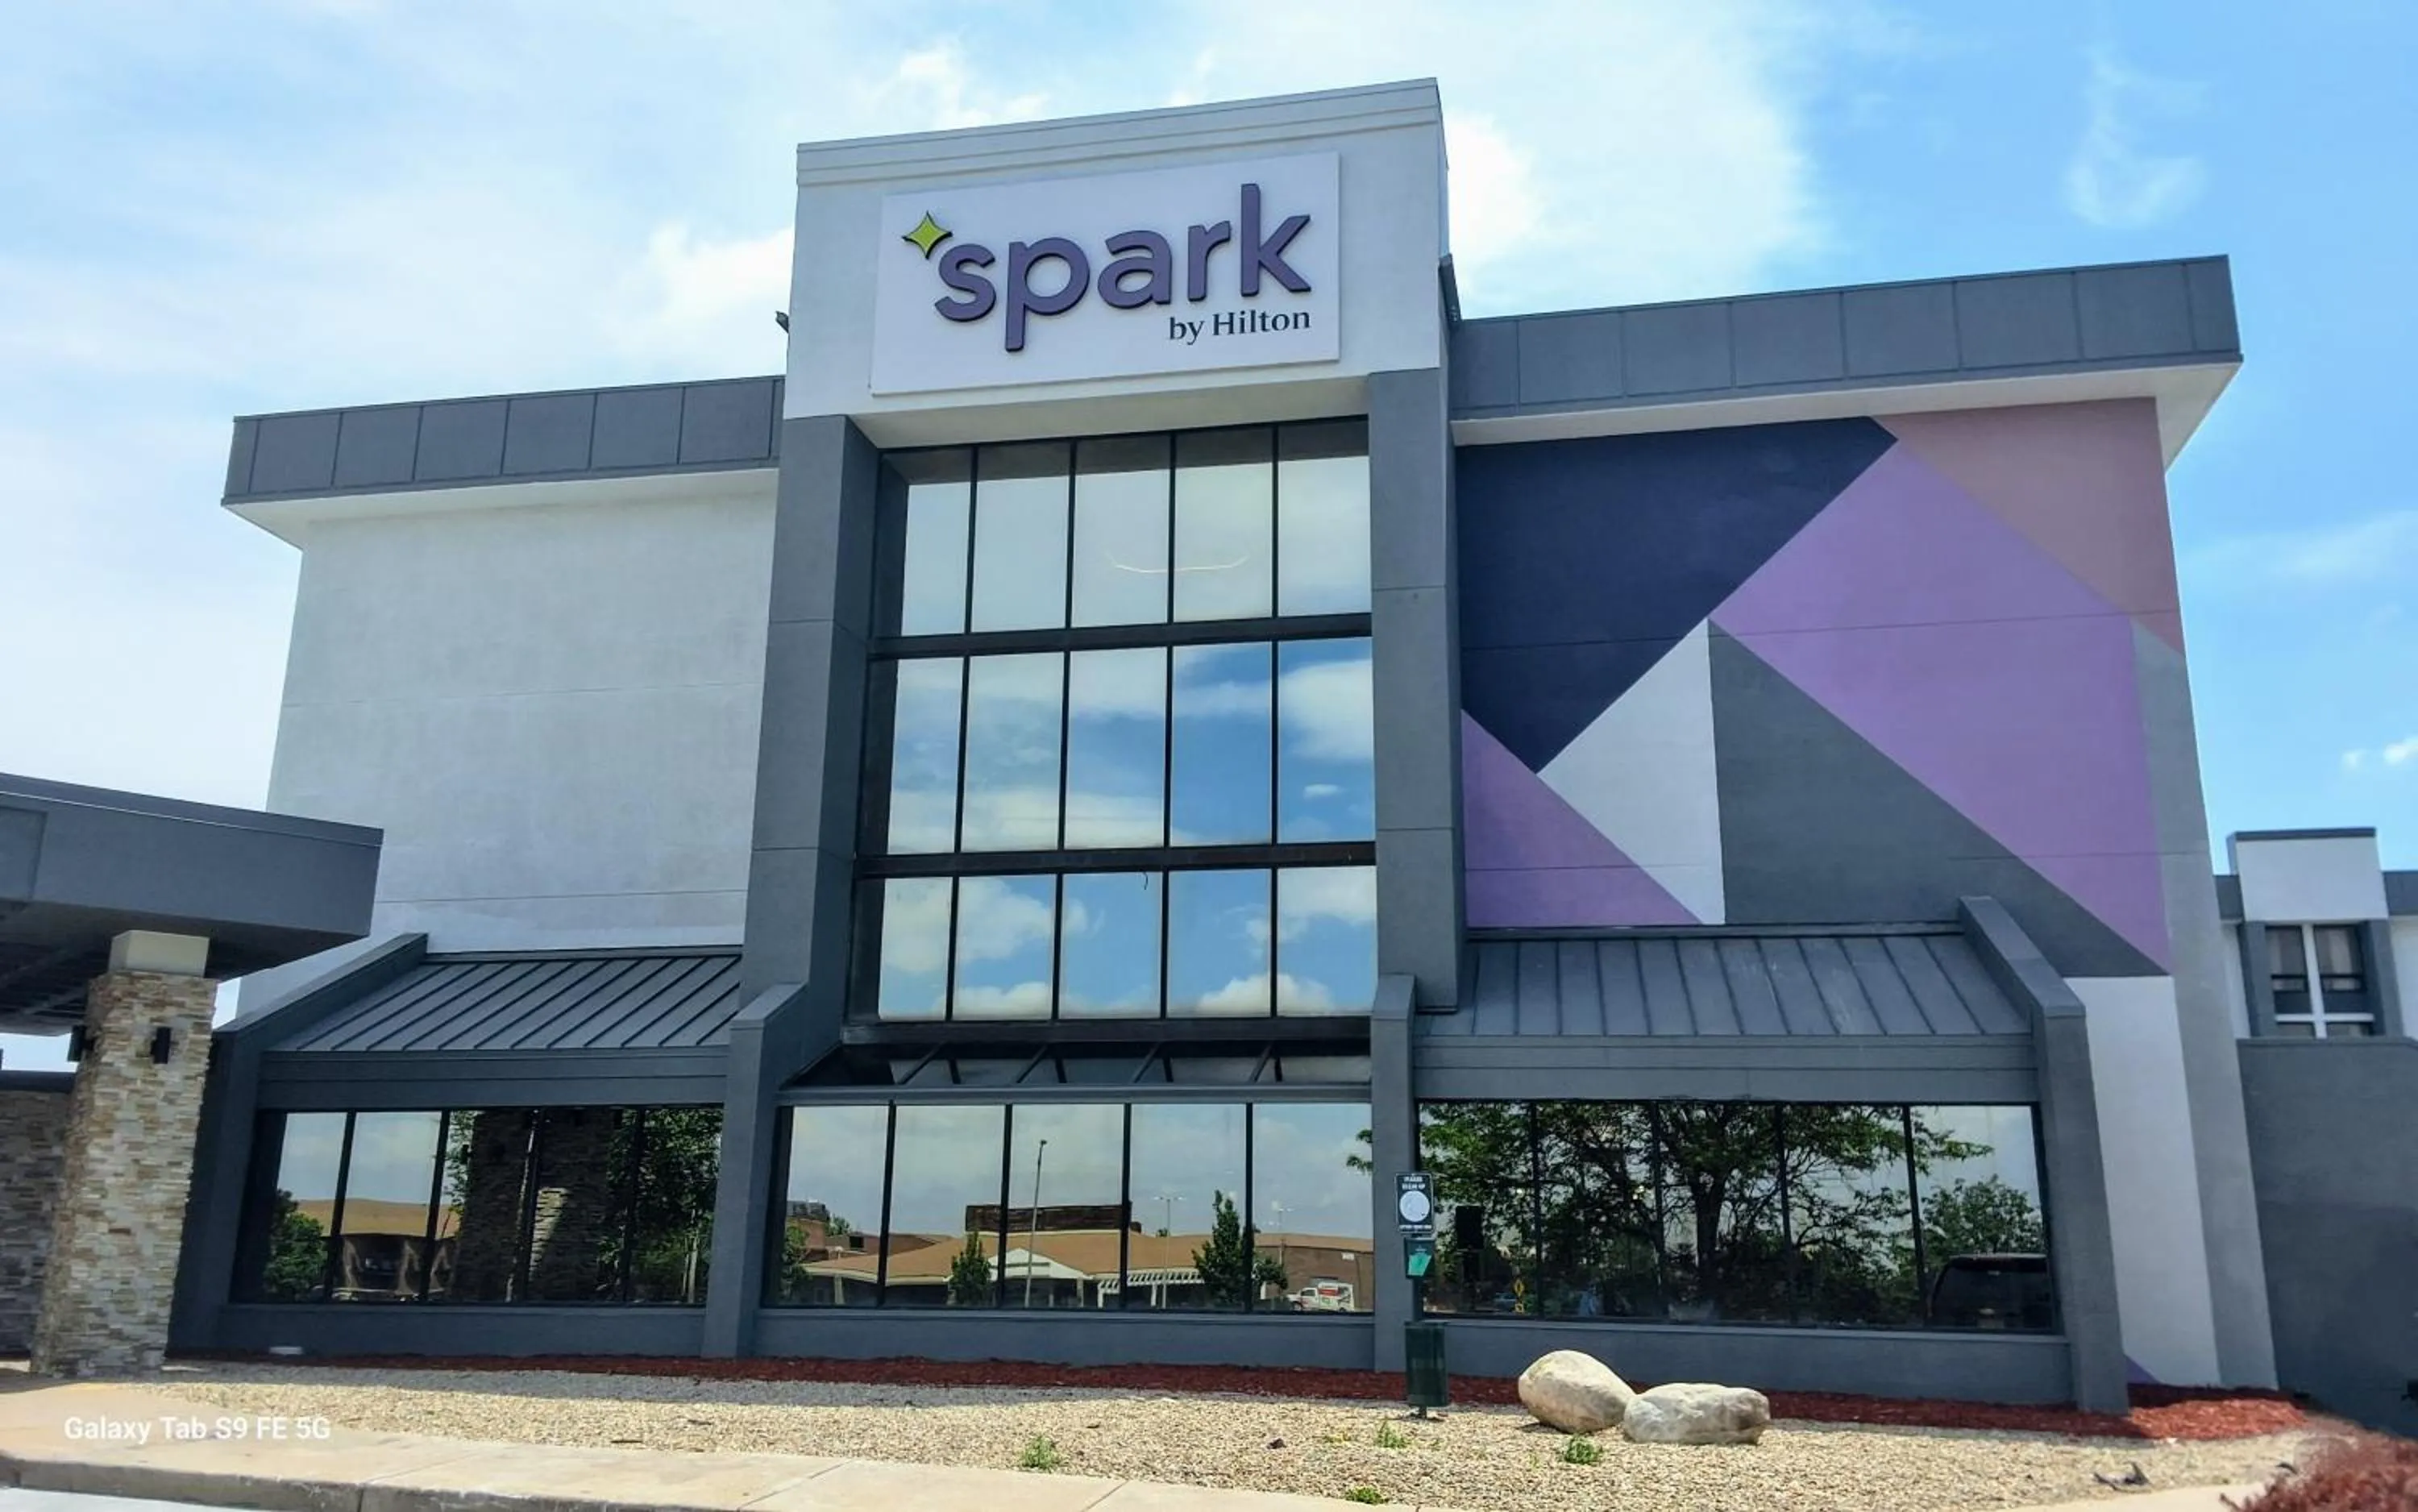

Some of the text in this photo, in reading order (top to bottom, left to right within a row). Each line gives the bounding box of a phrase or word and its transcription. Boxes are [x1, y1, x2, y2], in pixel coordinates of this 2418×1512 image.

[933, 183, 1311, 352] spark
[1169, 309, 1311, 346] by Hilton
